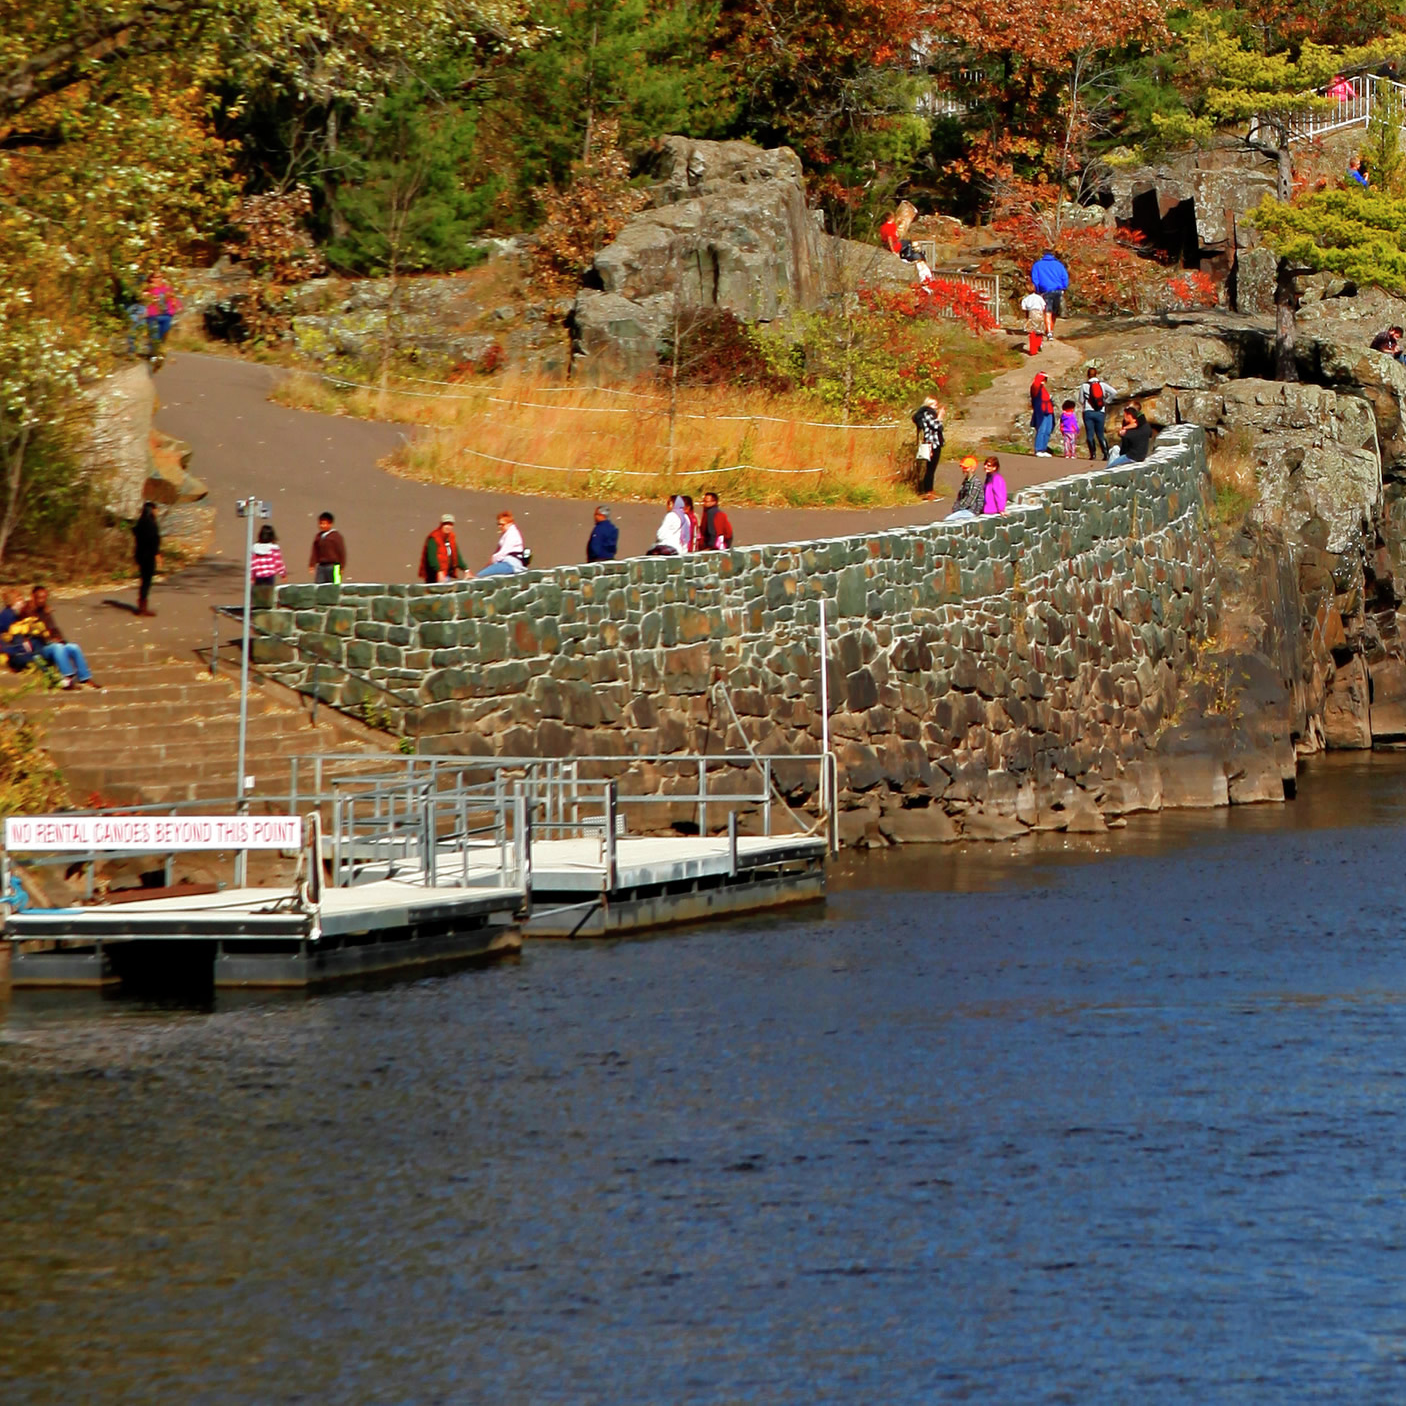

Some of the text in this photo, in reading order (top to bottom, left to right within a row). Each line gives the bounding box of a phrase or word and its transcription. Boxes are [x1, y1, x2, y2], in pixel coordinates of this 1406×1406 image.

[11, 822, 296, 843] NO RENTAL CANOES BEYOND THIS POINT
